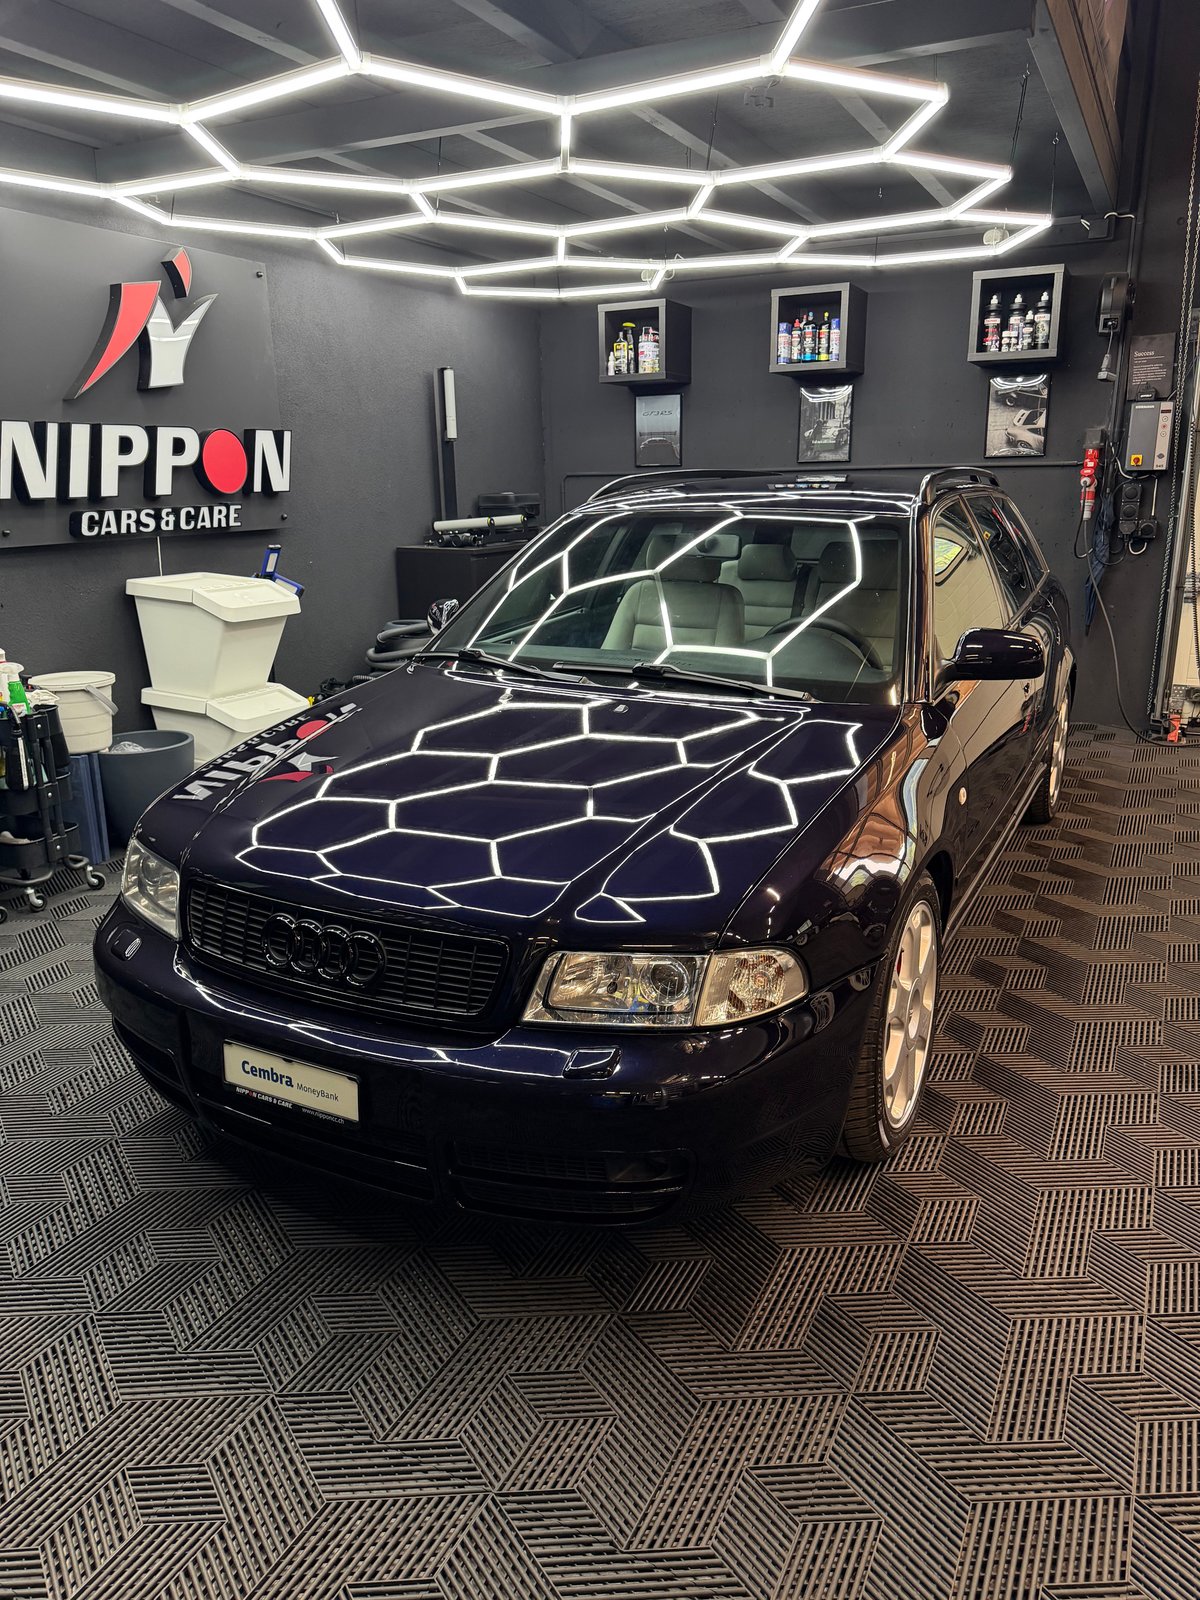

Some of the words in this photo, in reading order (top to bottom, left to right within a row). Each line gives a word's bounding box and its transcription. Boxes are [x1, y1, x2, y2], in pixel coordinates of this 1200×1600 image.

[0, 420, 293, 500] NIPPON
[241, 1060, 294, 1088] Cembra
[296, 1082, 339, 1102] MoneyBank
[257, 1093, 272, 1103] CARS
[277, 1099, 293, 1109] CARE
